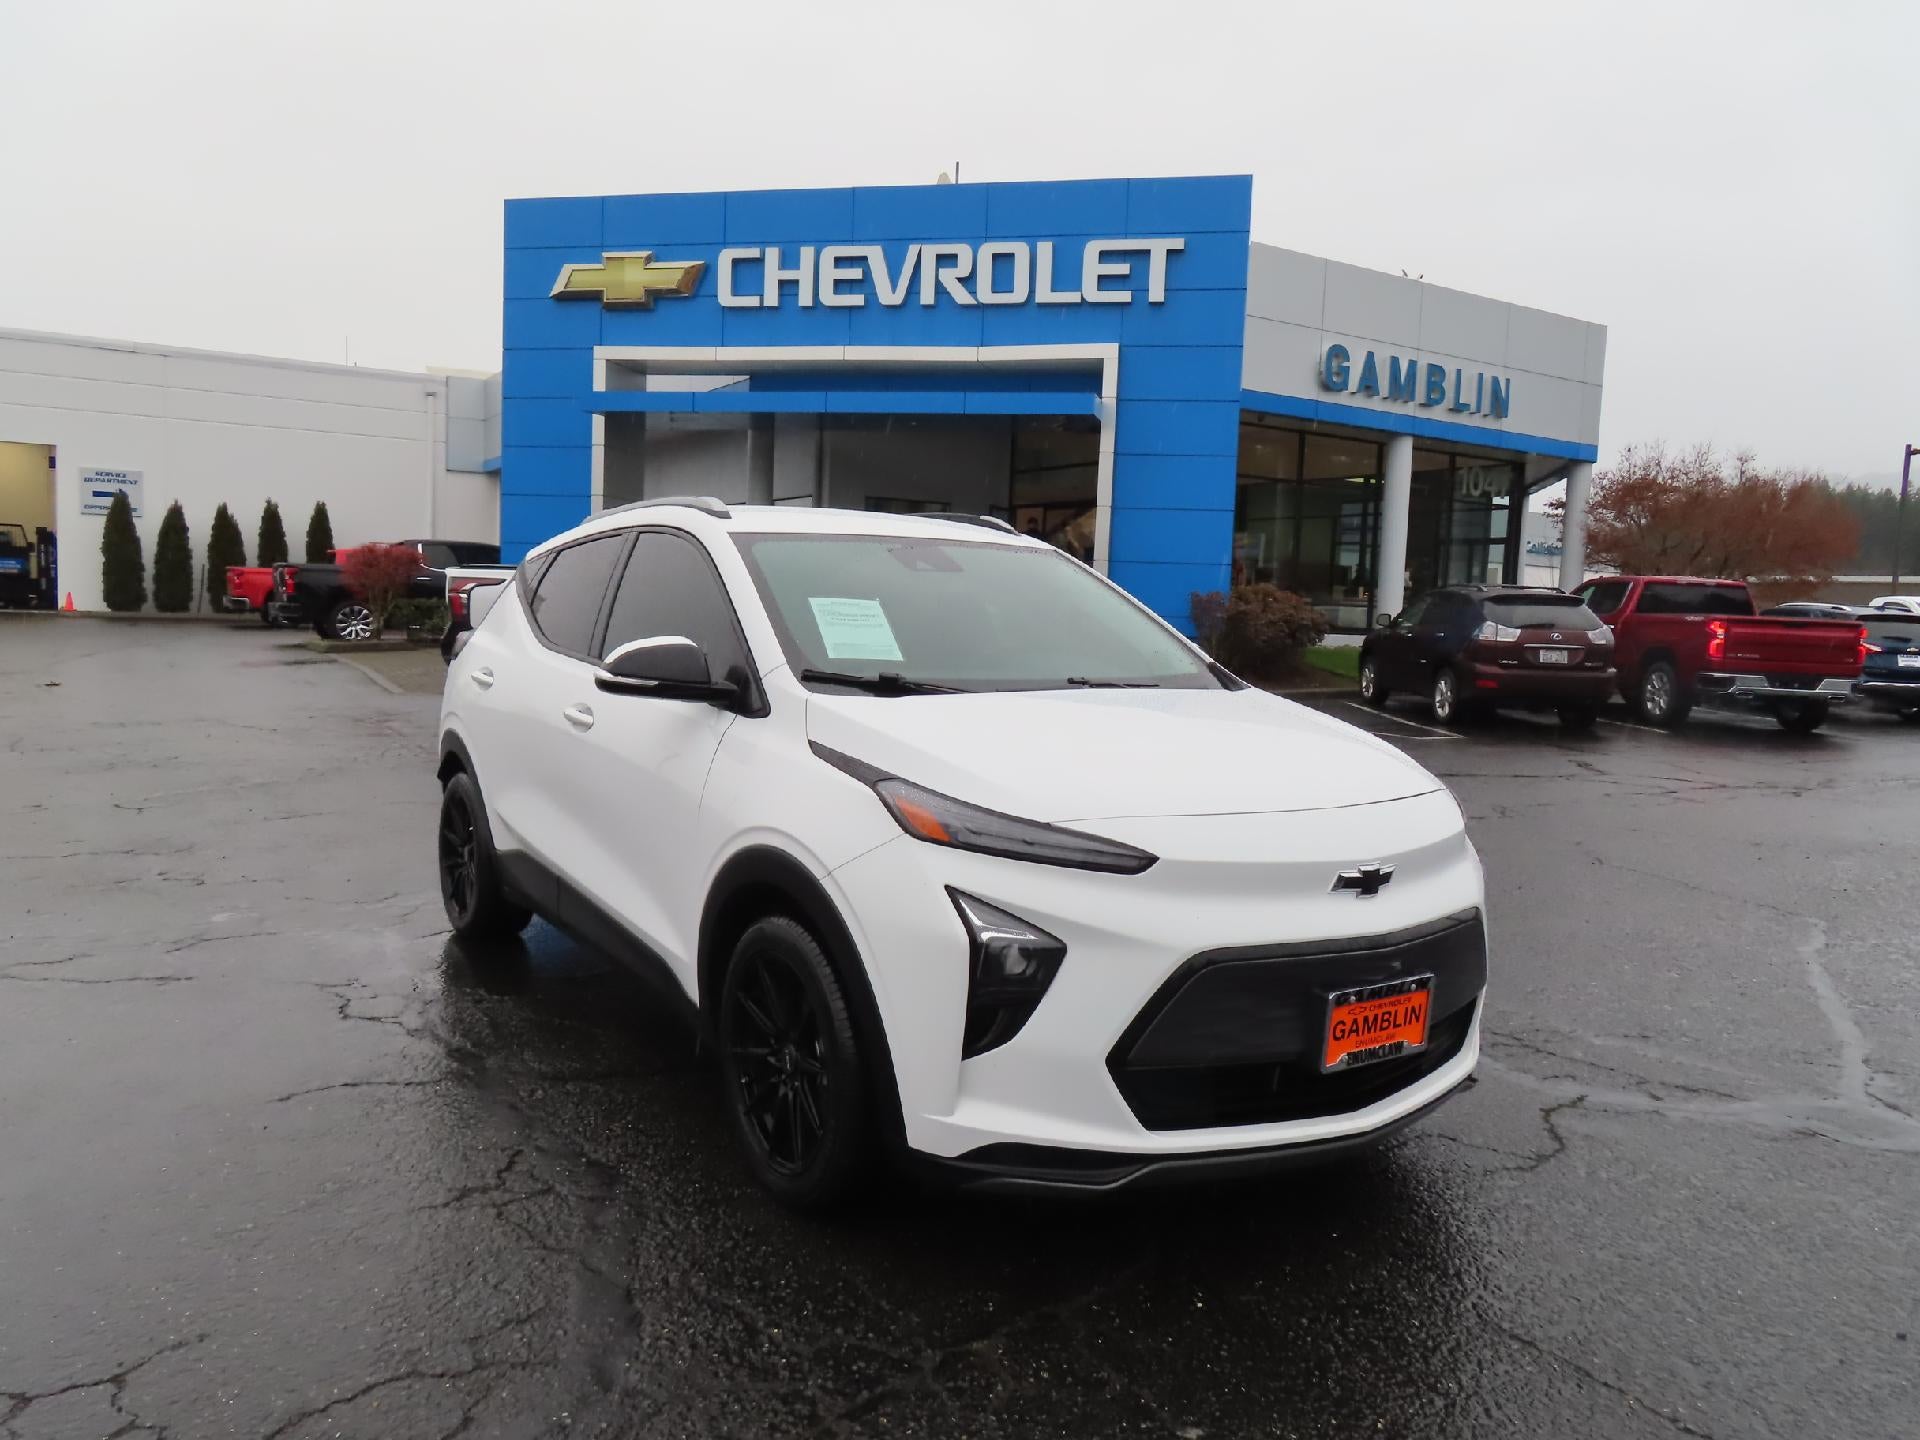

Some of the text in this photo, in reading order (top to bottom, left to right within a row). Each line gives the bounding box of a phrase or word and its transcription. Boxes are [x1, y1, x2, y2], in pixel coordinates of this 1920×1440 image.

[717, 237, 1185, 307] CHEVROLET
[1321, 343, 1511, 419] GAMBLIN
[83, 477, 138, 485] DEPARTMENT
[95, 471, 127, 479] SERVICE
[1332, 1004, 1422, 1042] GAMBLIN
